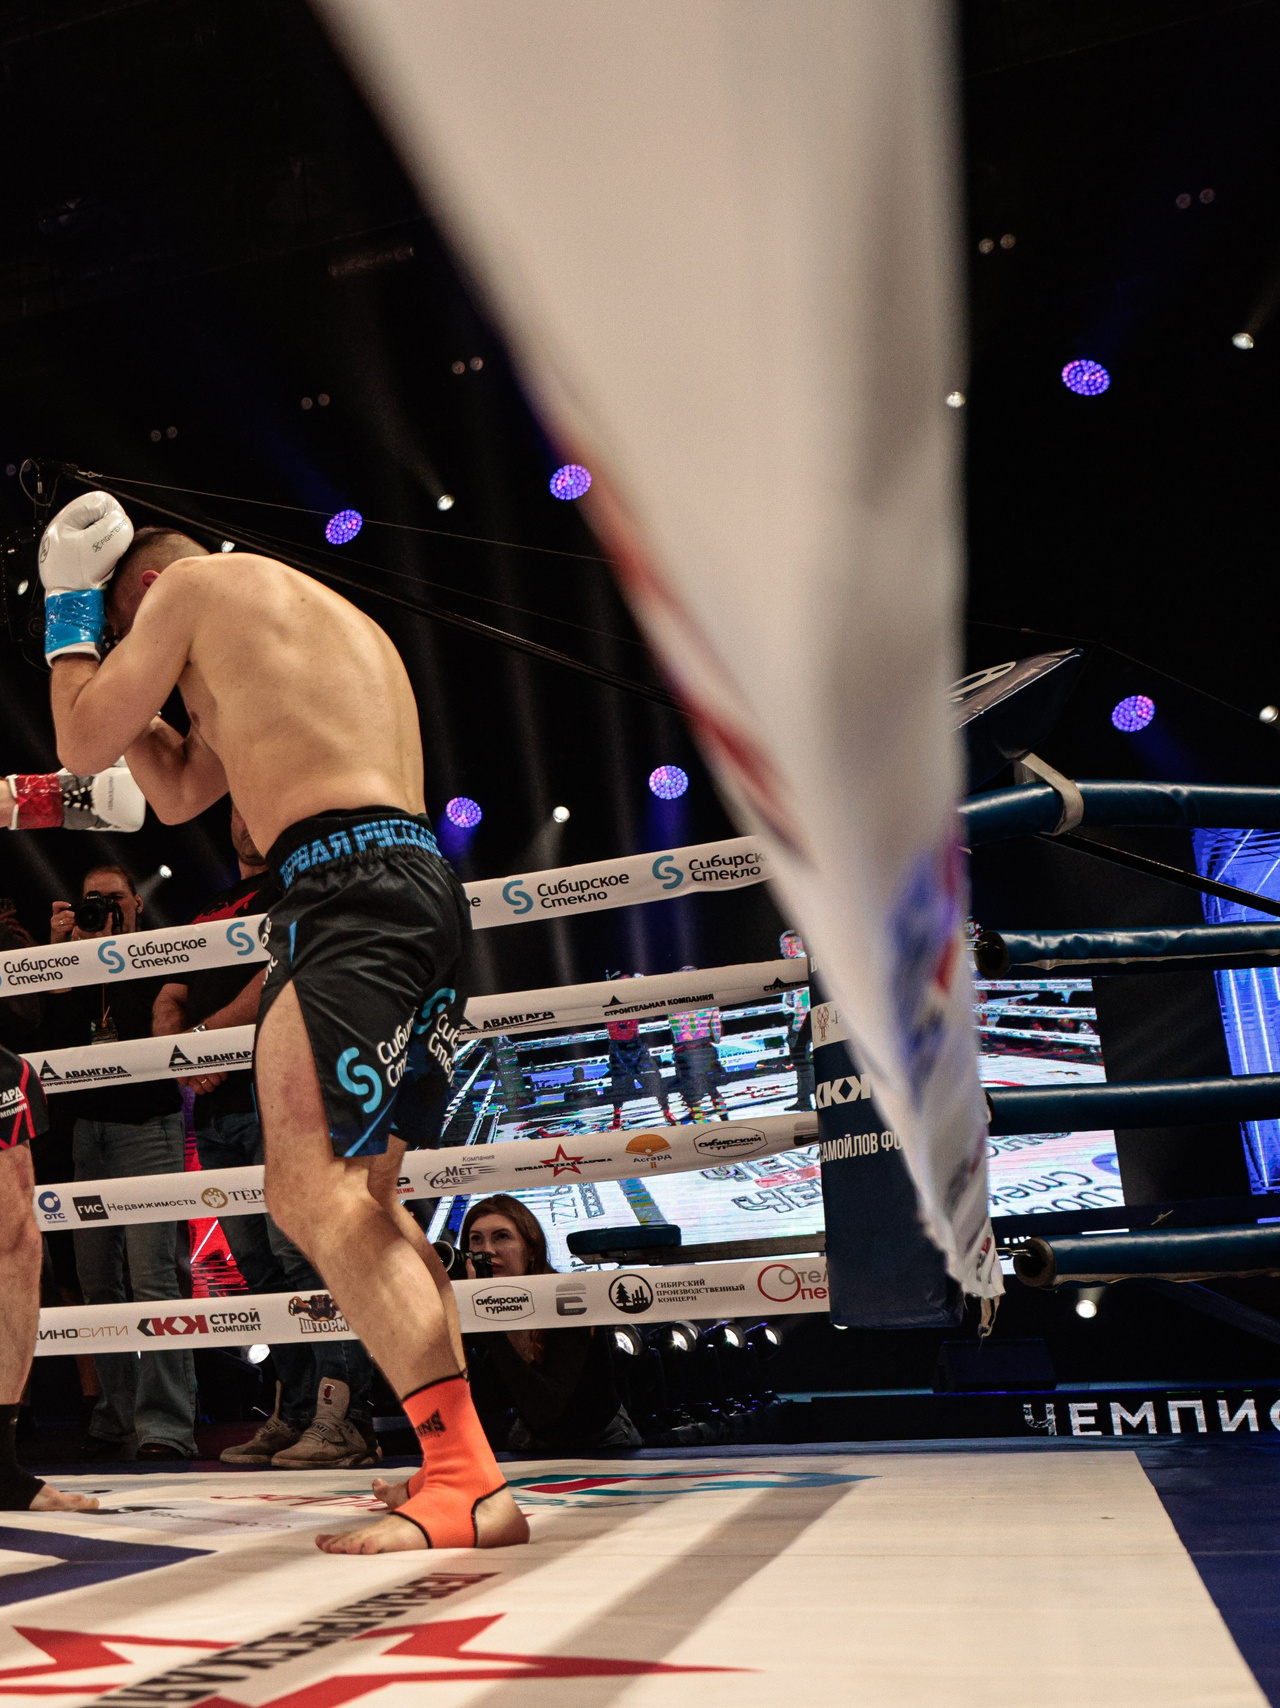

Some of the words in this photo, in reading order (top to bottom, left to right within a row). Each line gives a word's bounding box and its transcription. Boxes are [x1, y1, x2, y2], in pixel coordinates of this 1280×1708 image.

[691, 865, 761, 882] Стекло
[537, 872, 629, 897] Сибирское
[540, 889, 608, 909] Стекло
[127, 936, 207, 959] Сибирское
[3, 953, 80, 974] Сибирское
[131, 953, 190, 970] Стекло
[7, 971, 64, 986] Стекло
[604, 1000, 666, 1017] СТРОИТЕЛЬНАЯ
[667, 993, 715, 1007] КОМПАНИЯ
[197, 1050, 253, 1064] АВАНГАР
[65, 1065, 128, 1080] АВАНГАРД
[698, 1134, 762, 1148] сибирский
[633, 1153, 673, 1164] Асгард
[77, 1203, 104, 1214] ГИС
[108, 1198, 197, 1213] Недвижимость
[655, 1278, 705, 1289] СИБИРСКИЙ
[656, 1284, 745, 1296] ПРОИЗВОДСТВЕННЫЙ
[476, 1293, 530, 1306] сибирский
[486, 1303, 523, 1314] гурман
[209, 1308, 261, 1325] СТРОЙ
[212, 1323, 262, 1333] КОМПЛЕКТ
[299, 1317, 349, 1333] ШТОРМ
